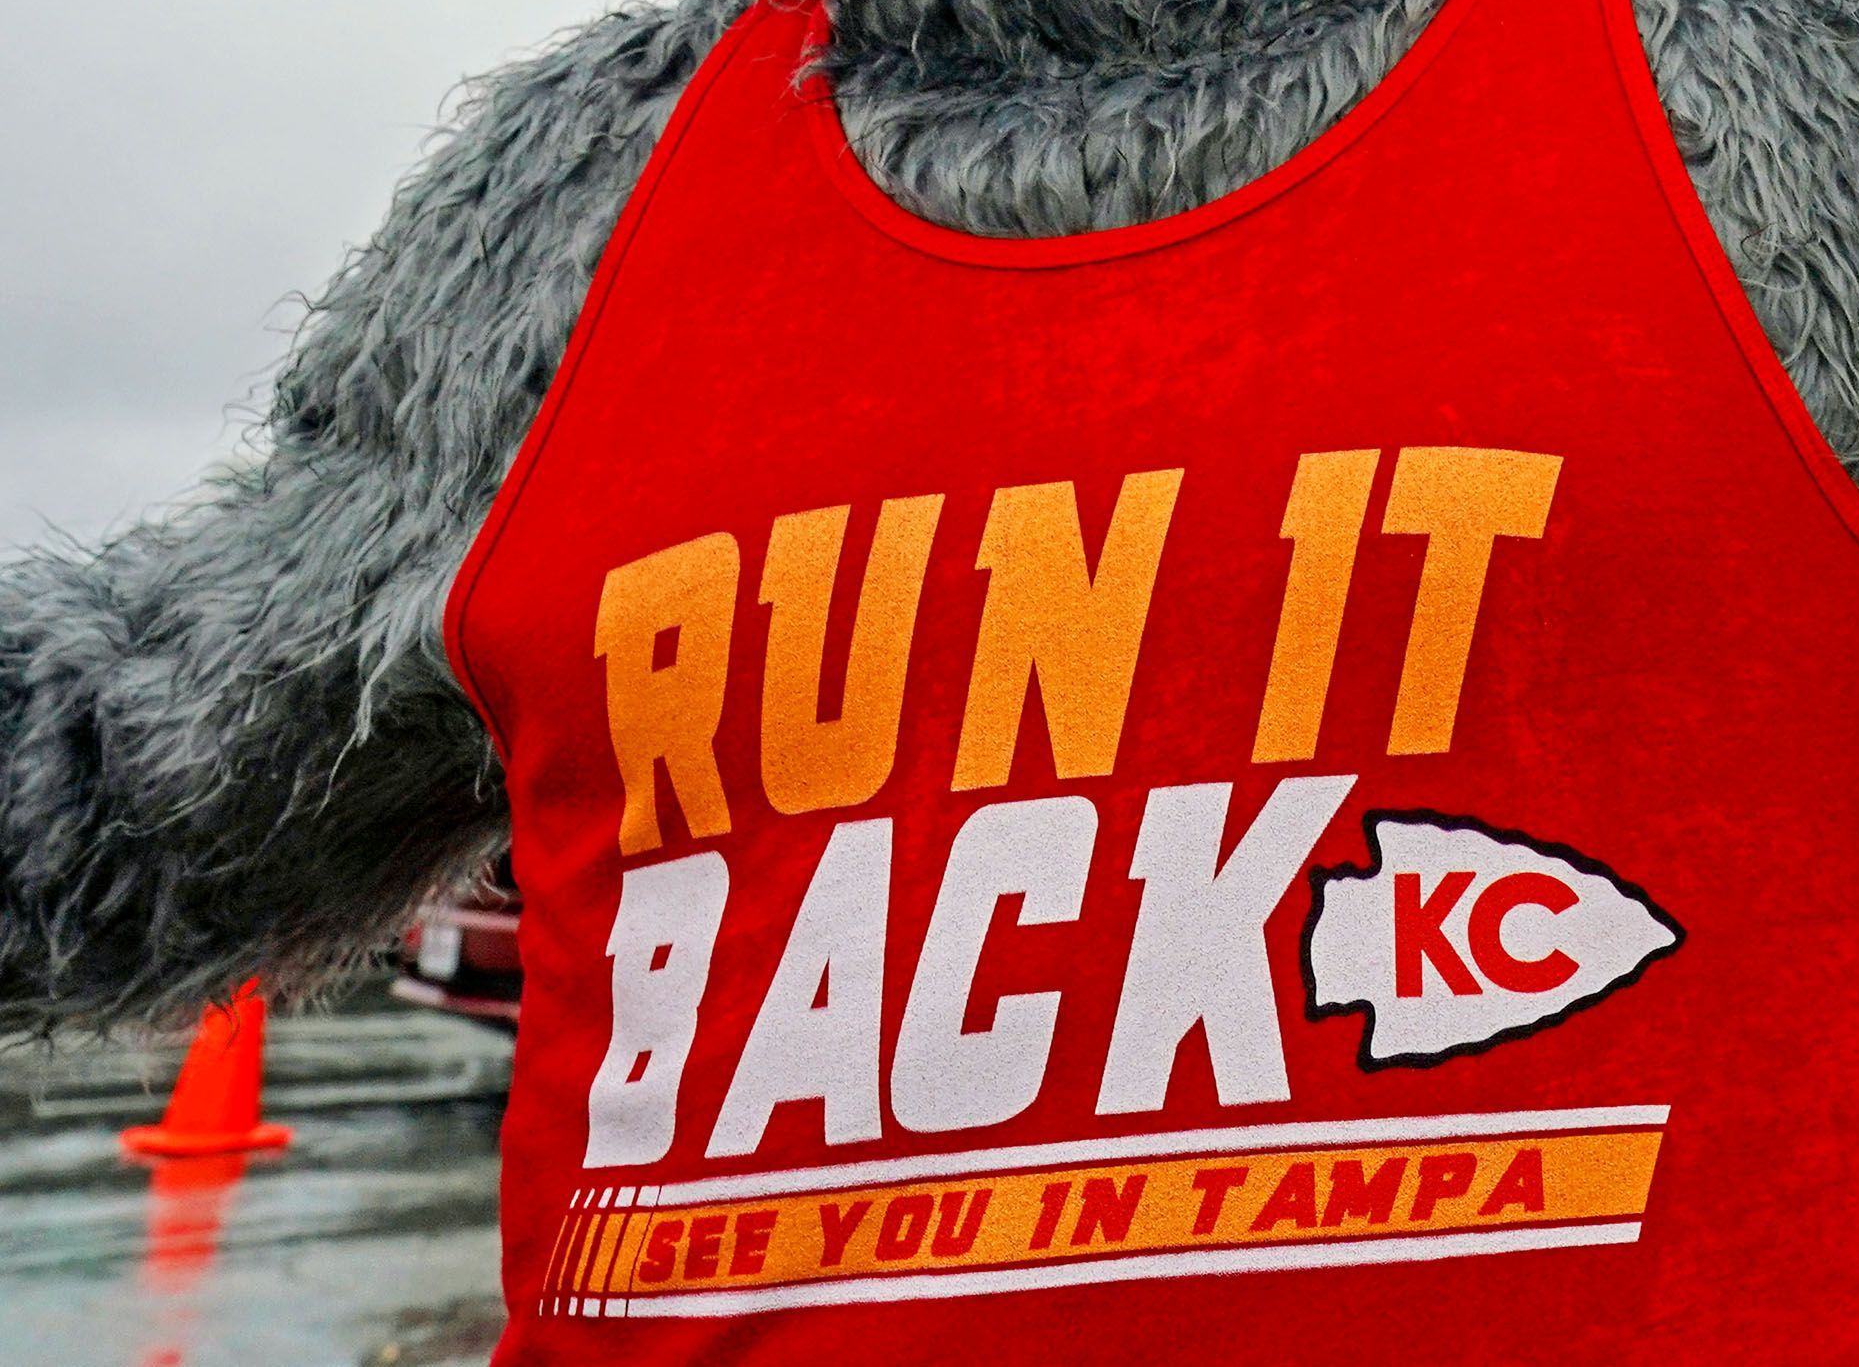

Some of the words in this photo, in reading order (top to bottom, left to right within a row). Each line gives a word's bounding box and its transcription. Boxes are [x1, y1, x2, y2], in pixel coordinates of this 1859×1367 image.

[593, 466, 1186, 857] RUN
[1249, 446, 1565, 766] IT
[581, 774, 1360, 1170] BACK
[1394, 869, 1583, 1000] KC
[638, 1209, 779, 1284] SEE
[818, 1188, 994, 1268] YOU
[1029, 1174, 1149, 1251] IN
[1193, 1148, 1548, 1236] TAMPA
